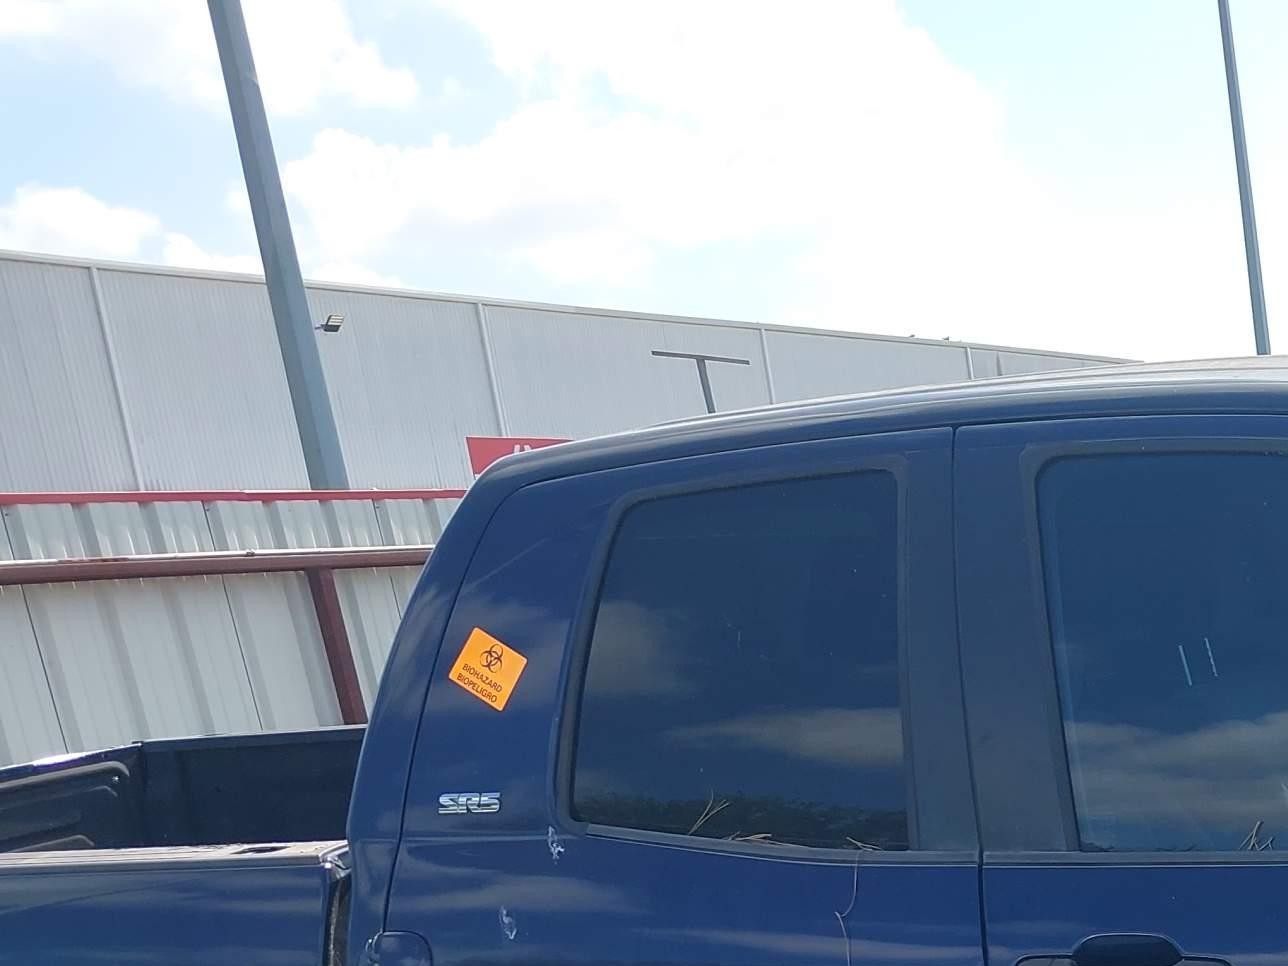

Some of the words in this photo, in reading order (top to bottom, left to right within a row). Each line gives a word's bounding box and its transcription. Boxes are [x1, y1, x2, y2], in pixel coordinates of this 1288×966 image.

[456, 672, 498, 703] BIOPELIGRO
[462, 663, 503, 693] BIOHAZARD
[438, 792, 502, 814] SR5
